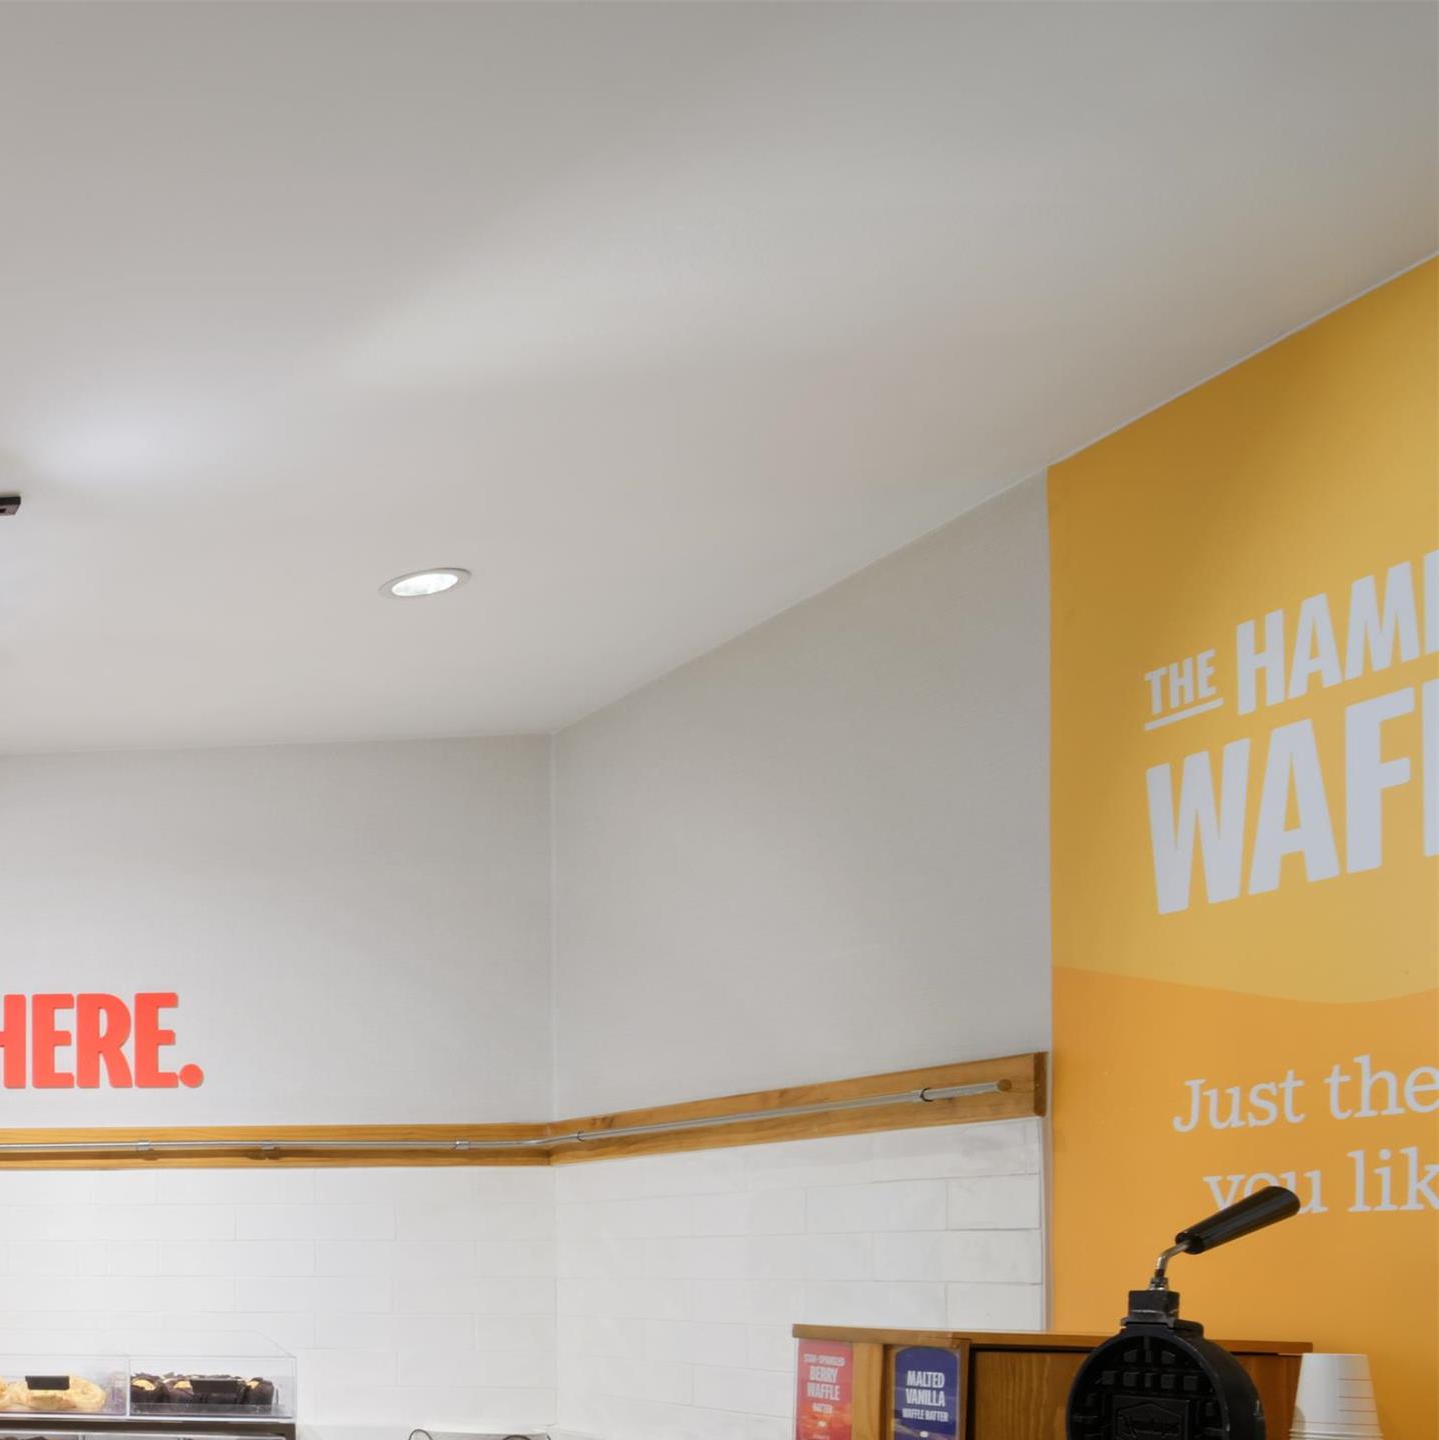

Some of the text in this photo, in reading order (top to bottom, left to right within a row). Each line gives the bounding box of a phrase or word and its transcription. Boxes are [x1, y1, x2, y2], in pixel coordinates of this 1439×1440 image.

[1144, 648, 1219, 716] THE
[1172, 1053, 1439, 1133] Just the
[906, 1369, 946, 1389] MALTED
[806, 1381, 841, 1401] WAFFLE
[905, 1387, 946, 1408] VANILLA
[902, 1407, 950, 1422] WAFFLE BATTER
